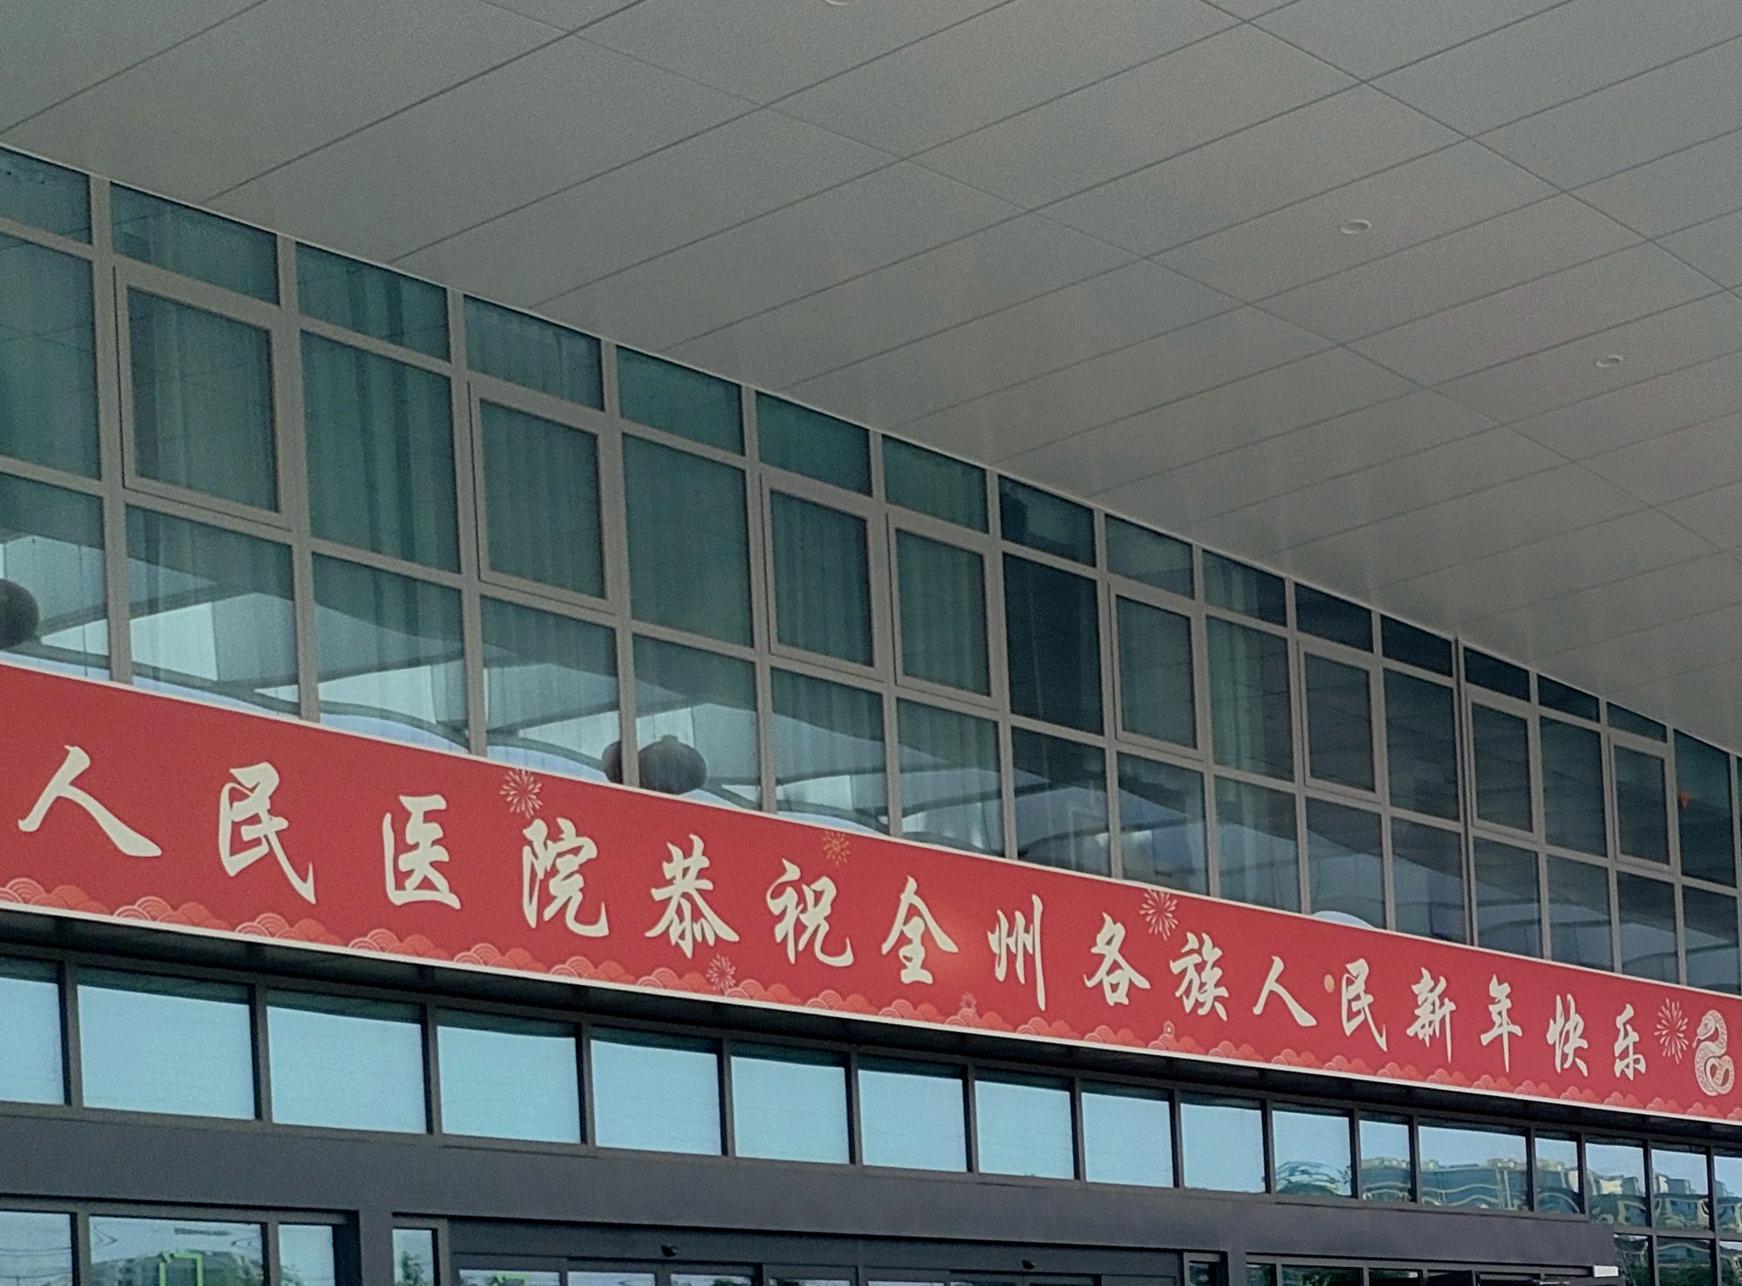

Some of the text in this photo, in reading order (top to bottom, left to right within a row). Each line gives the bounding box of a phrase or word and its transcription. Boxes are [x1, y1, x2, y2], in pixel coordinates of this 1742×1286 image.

[18, 744, 1648, 1079] 人民医院恭祝全州各族人民新年快乐
